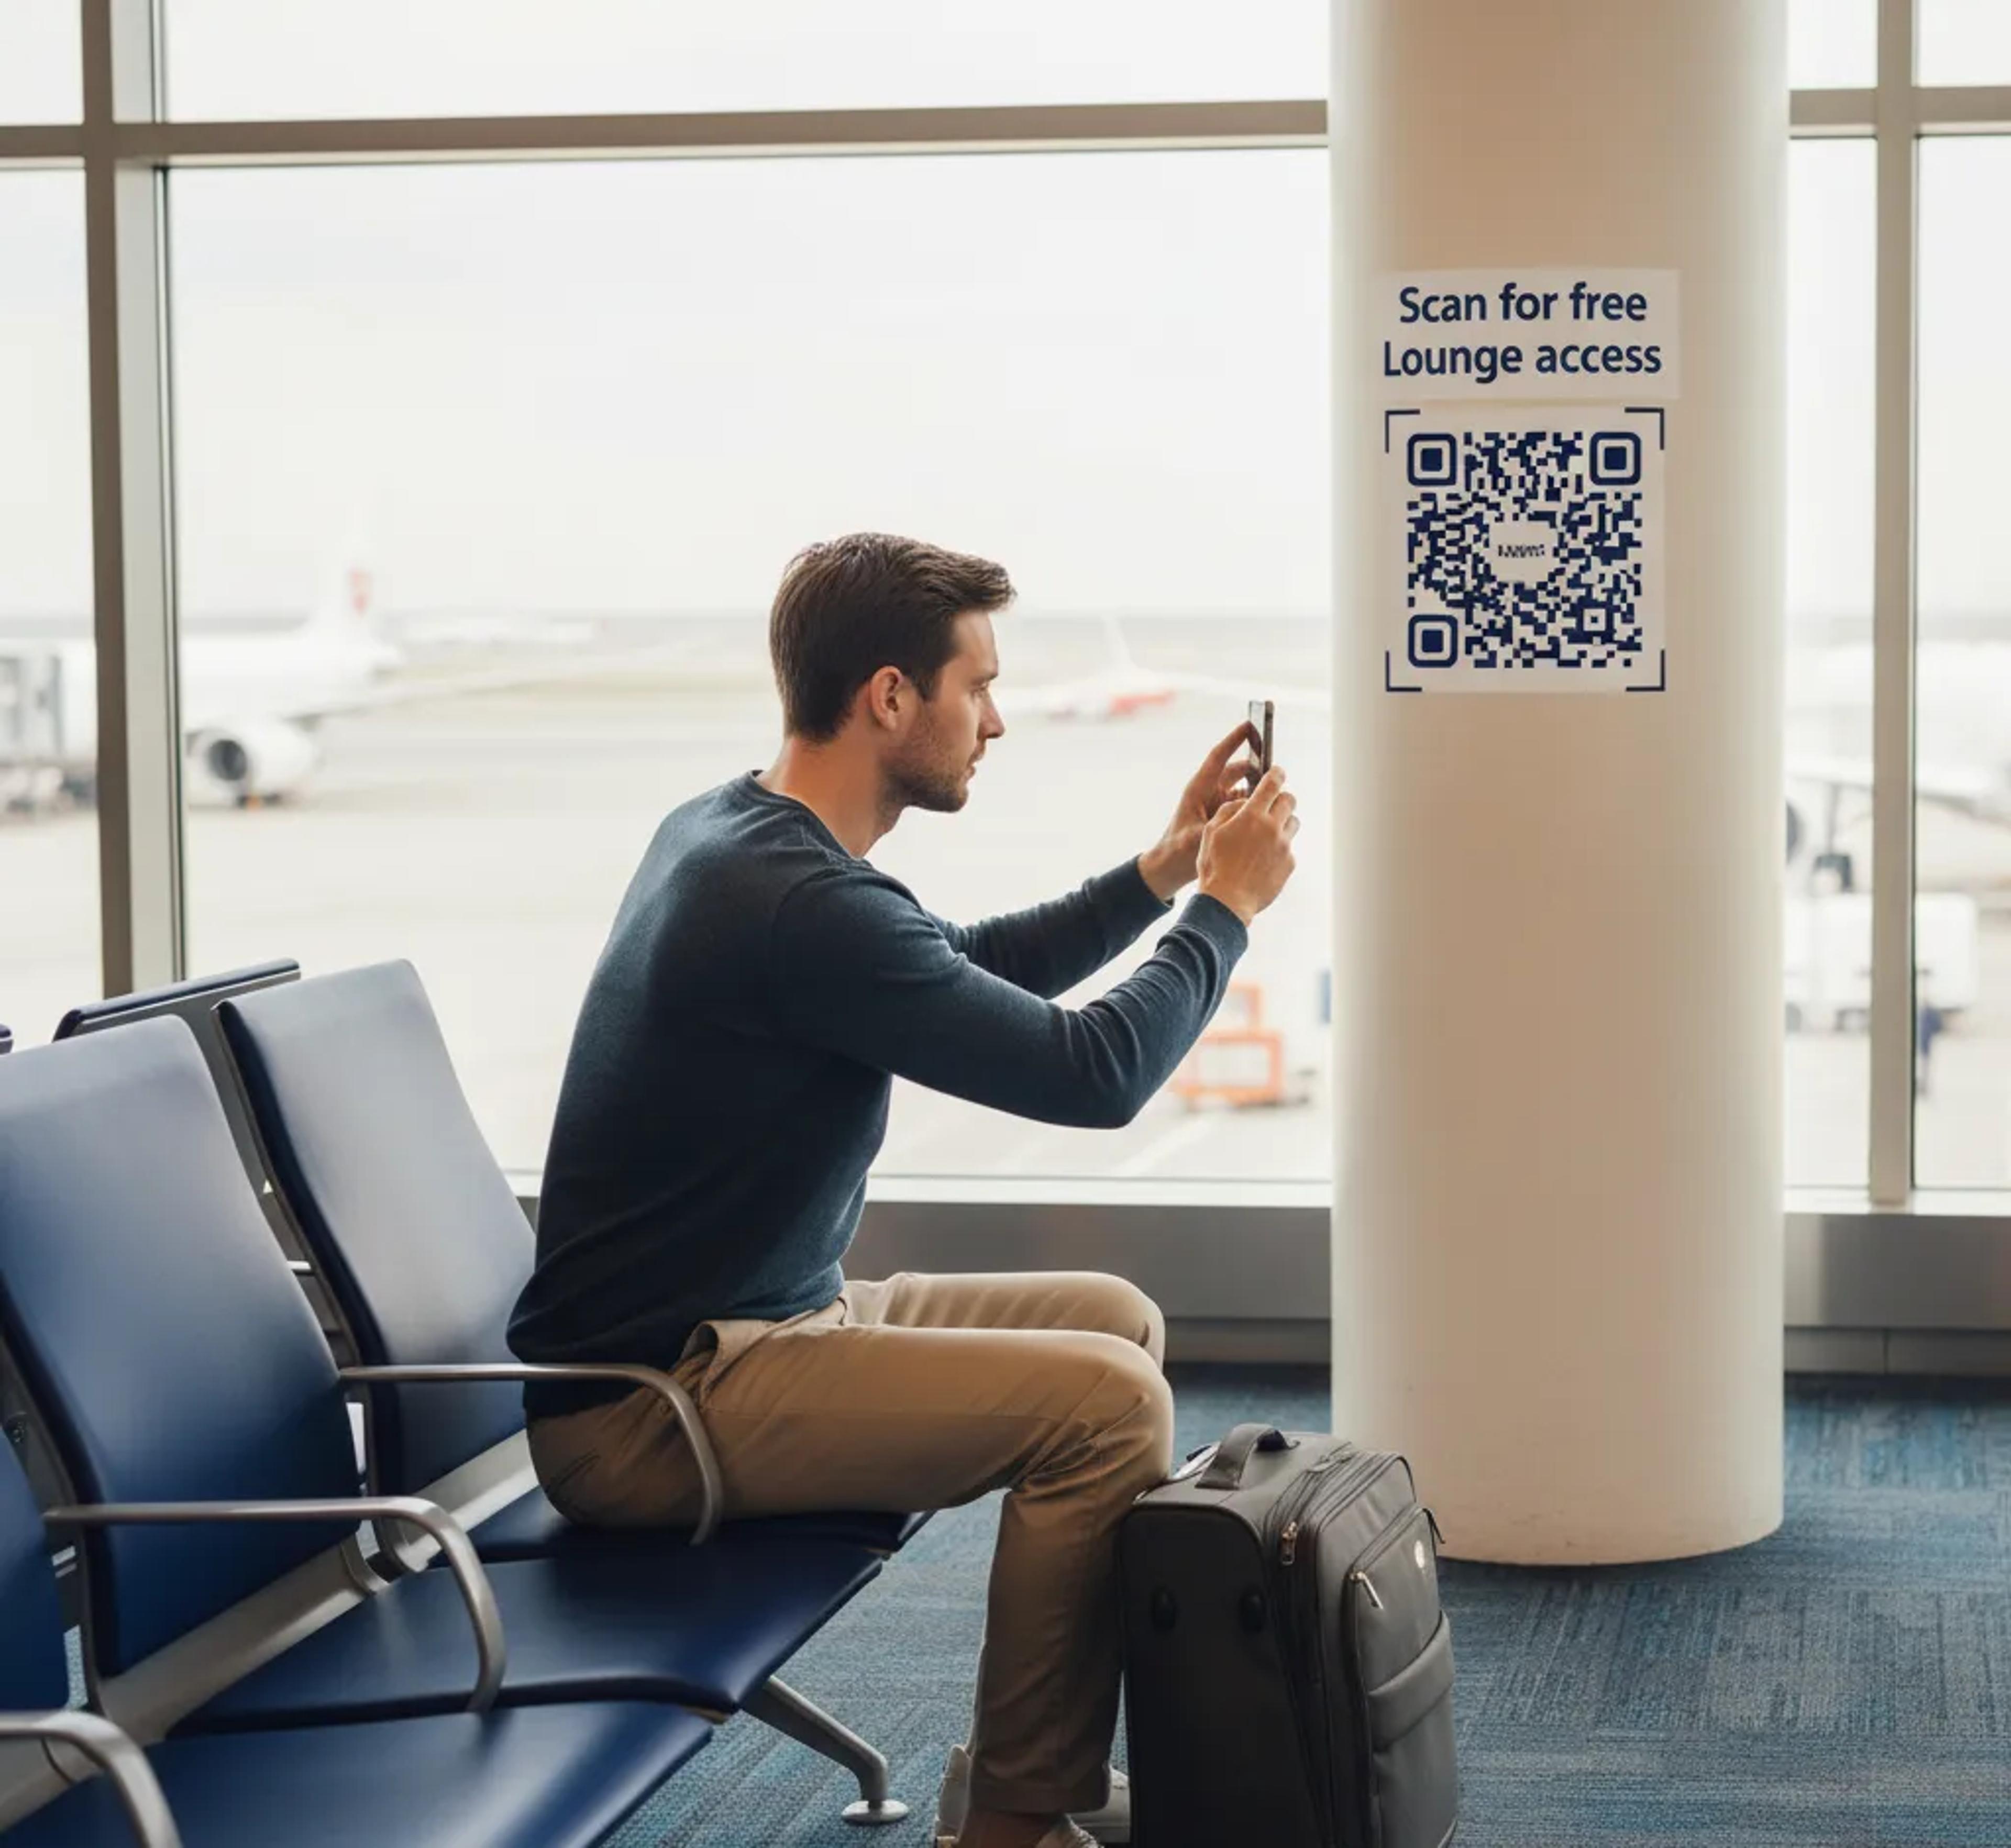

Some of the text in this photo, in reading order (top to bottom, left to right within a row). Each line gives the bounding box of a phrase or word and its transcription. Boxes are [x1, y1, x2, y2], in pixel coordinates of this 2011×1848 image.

[1399, 281, 1648, 323] Scan for free
[1384, 340, 1662, 384] Lounge access
